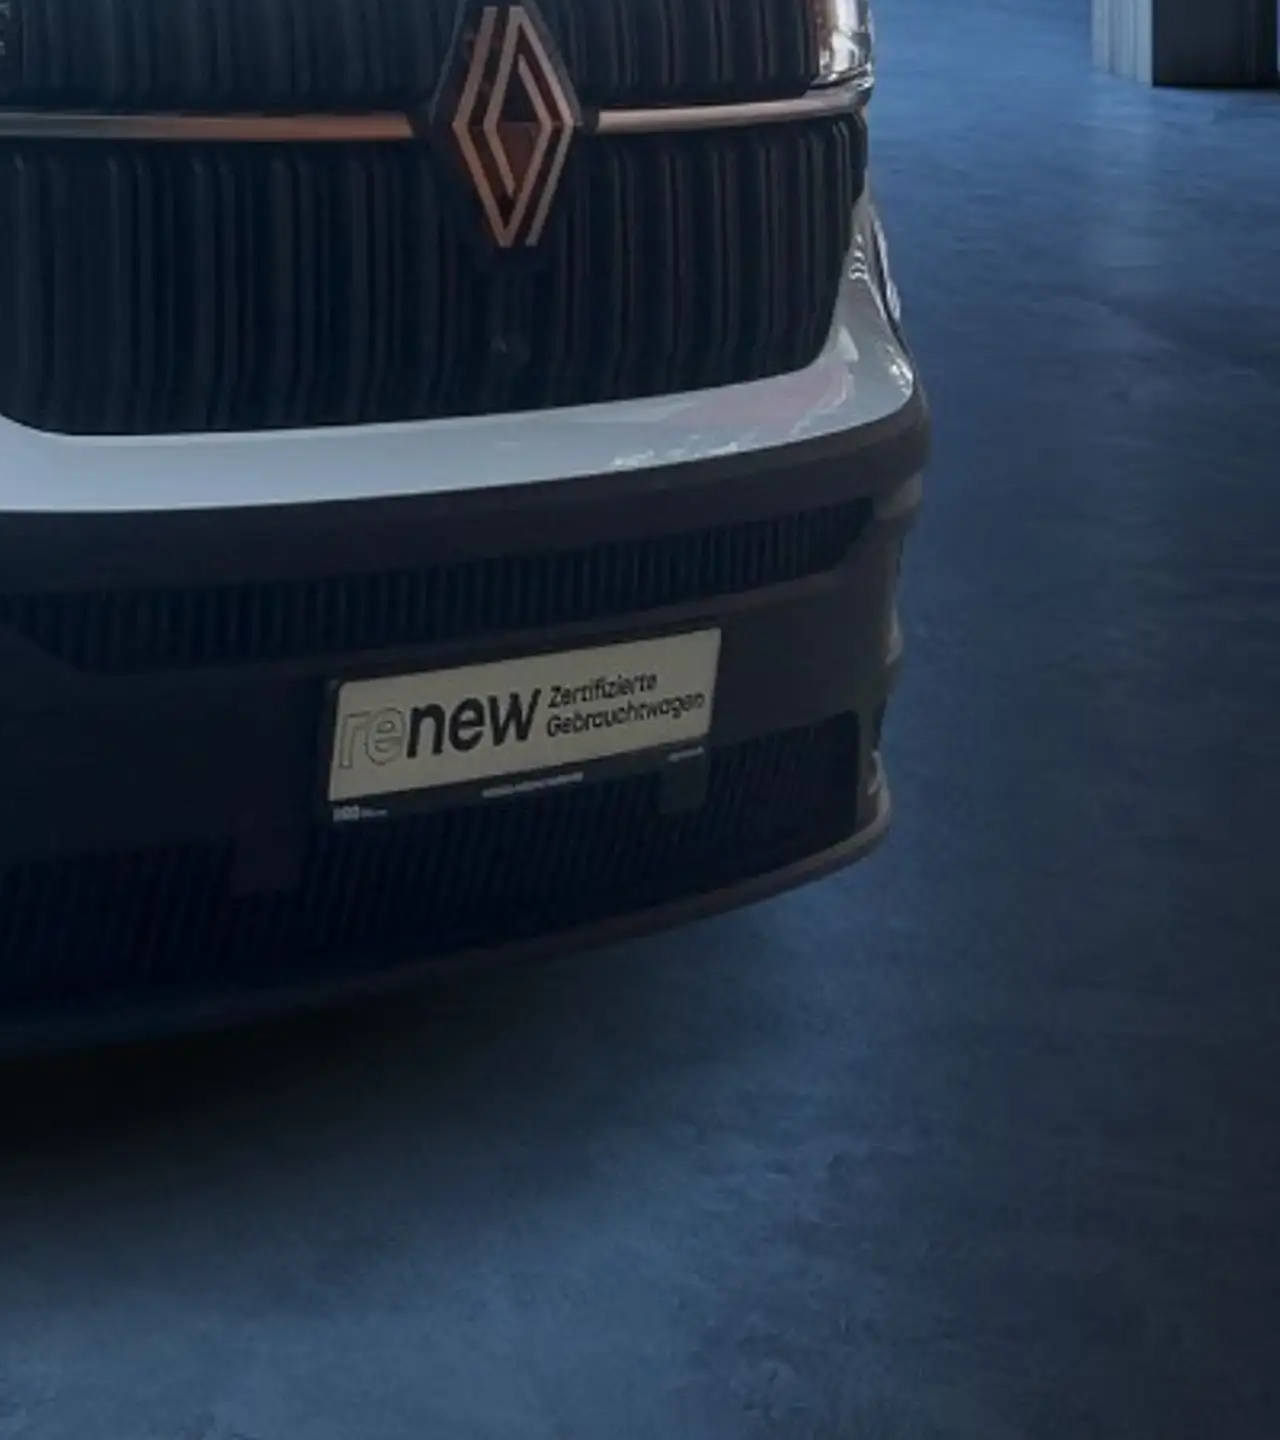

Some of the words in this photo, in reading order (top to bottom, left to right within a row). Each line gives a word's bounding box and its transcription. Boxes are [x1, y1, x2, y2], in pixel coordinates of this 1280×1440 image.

[547, 672, 658, 709] Zertifizierte
[339, 687, 542, 770] renew
[546, 691, 706, 738] Gebrauchtwagen
